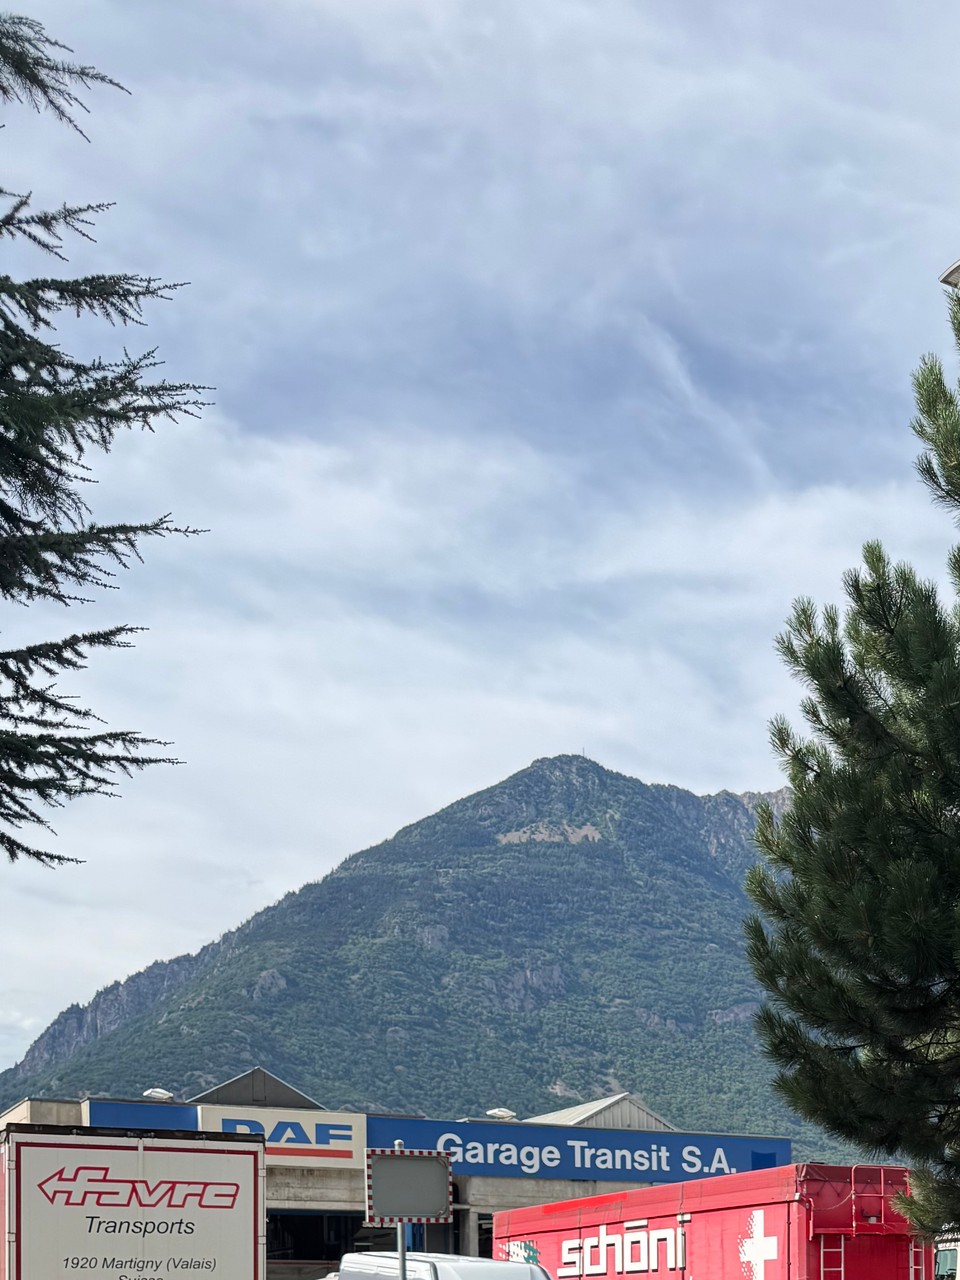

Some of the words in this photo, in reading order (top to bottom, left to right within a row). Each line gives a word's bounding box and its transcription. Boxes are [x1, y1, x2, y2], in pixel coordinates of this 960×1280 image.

[222, 1118, 352, 1145] DAF
[436, 1133, 561, 1174] Garage
[567, 1140, 670, 1172] Transit
[681, 1145, 737, 1174] S.A.
[85, 1216, 195, 1237] Transports
[63, 1257, 98, 1269] 1920
[102, 1257, 162, 1272] Martigny
[166, 1257, 217, 1272] (Valais)
